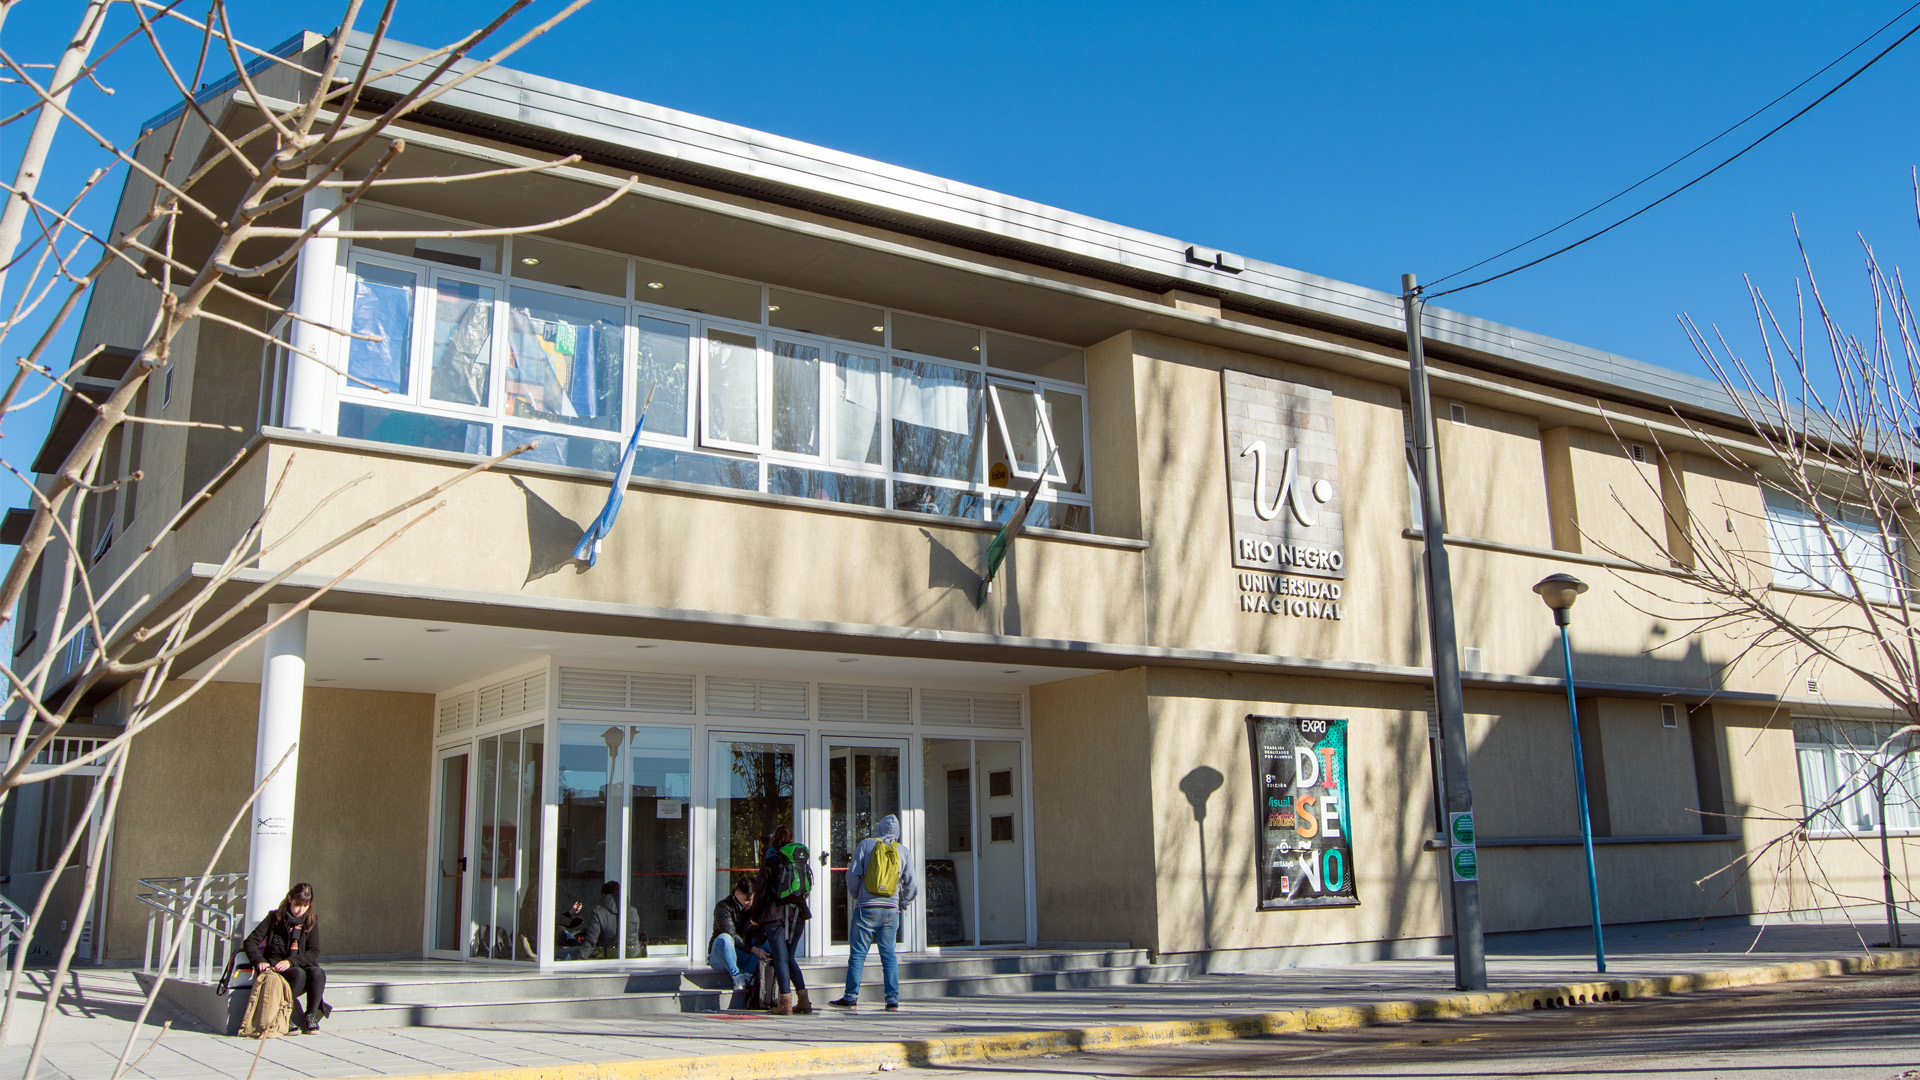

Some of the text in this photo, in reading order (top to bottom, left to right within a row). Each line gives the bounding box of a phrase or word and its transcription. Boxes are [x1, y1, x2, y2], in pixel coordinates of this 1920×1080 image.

[1240, 539, 1344, 571] RIO NEGRO
[1239, 573, 1342, 600] UNIVERSIDAD
[1241, 594, 1343, 620] NACIONAL
[1302, 720, 1326, 733] EXPO
